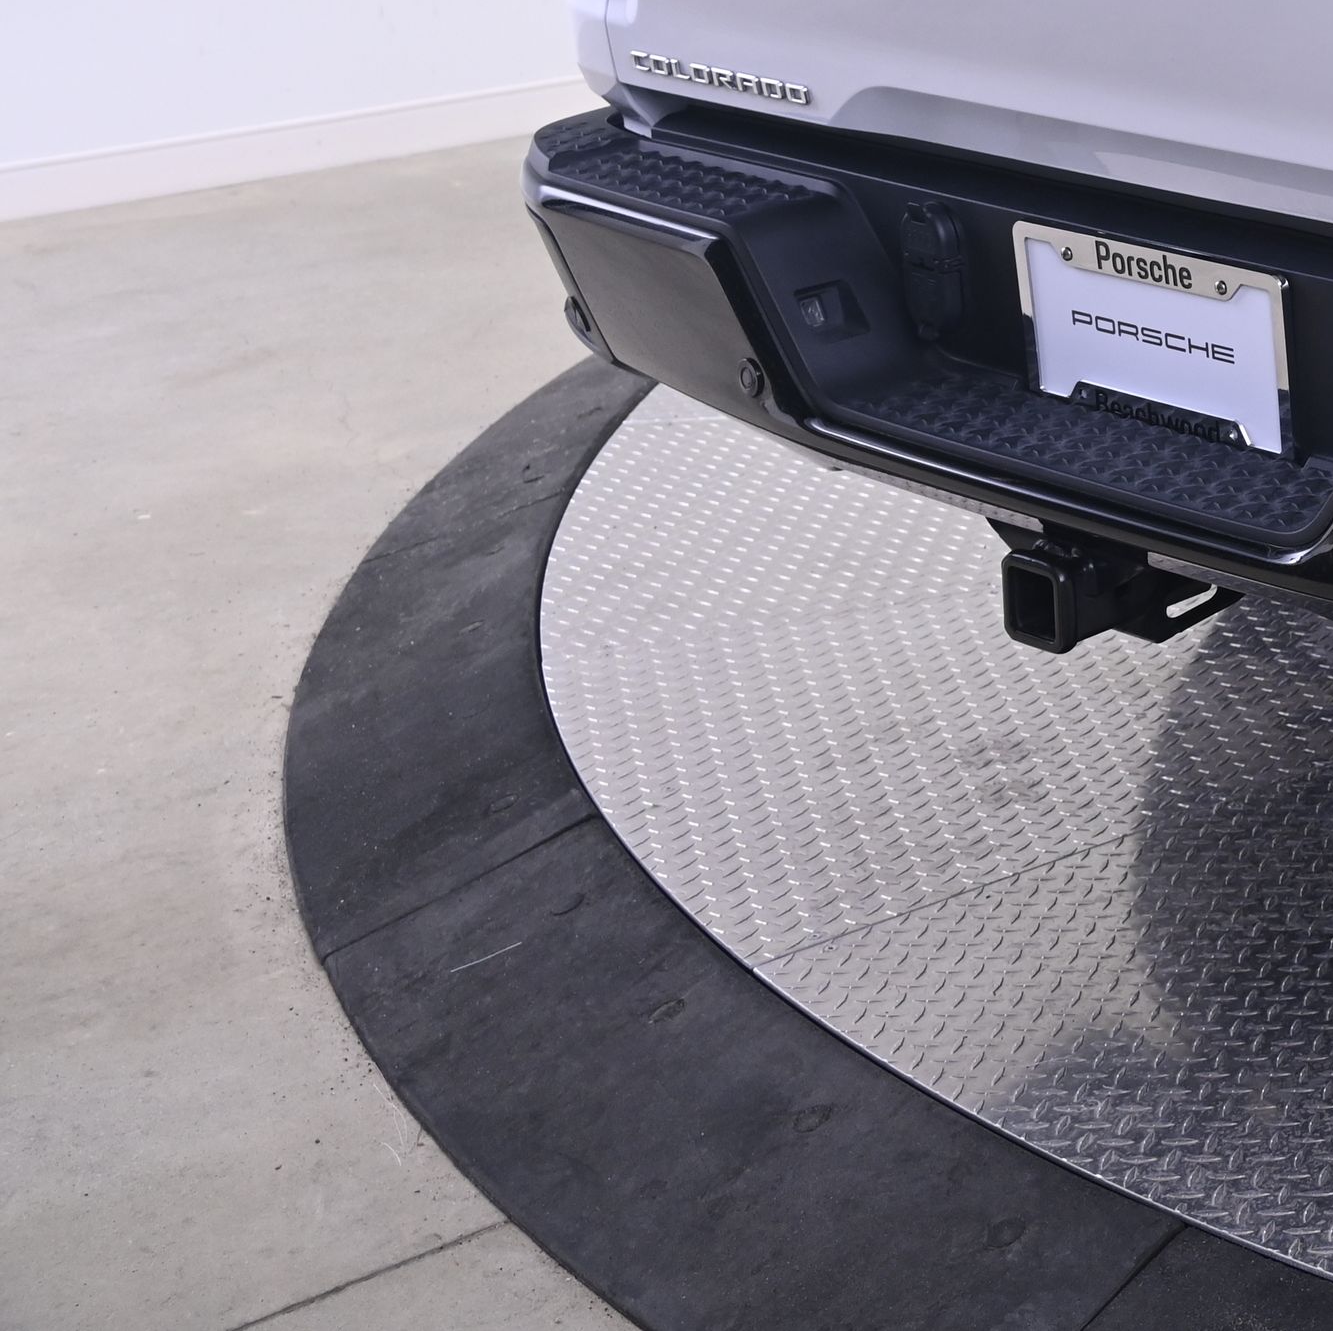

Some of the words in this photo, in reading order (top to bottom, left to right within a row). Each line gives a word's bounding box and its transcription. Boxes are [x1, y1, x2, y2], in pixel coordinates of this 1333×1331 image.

[630, 50, 810, 105] COLORADO
[1095, 240, 1193, 289] Porsche
[1072, 310, 1235, 364] PORSCHE
